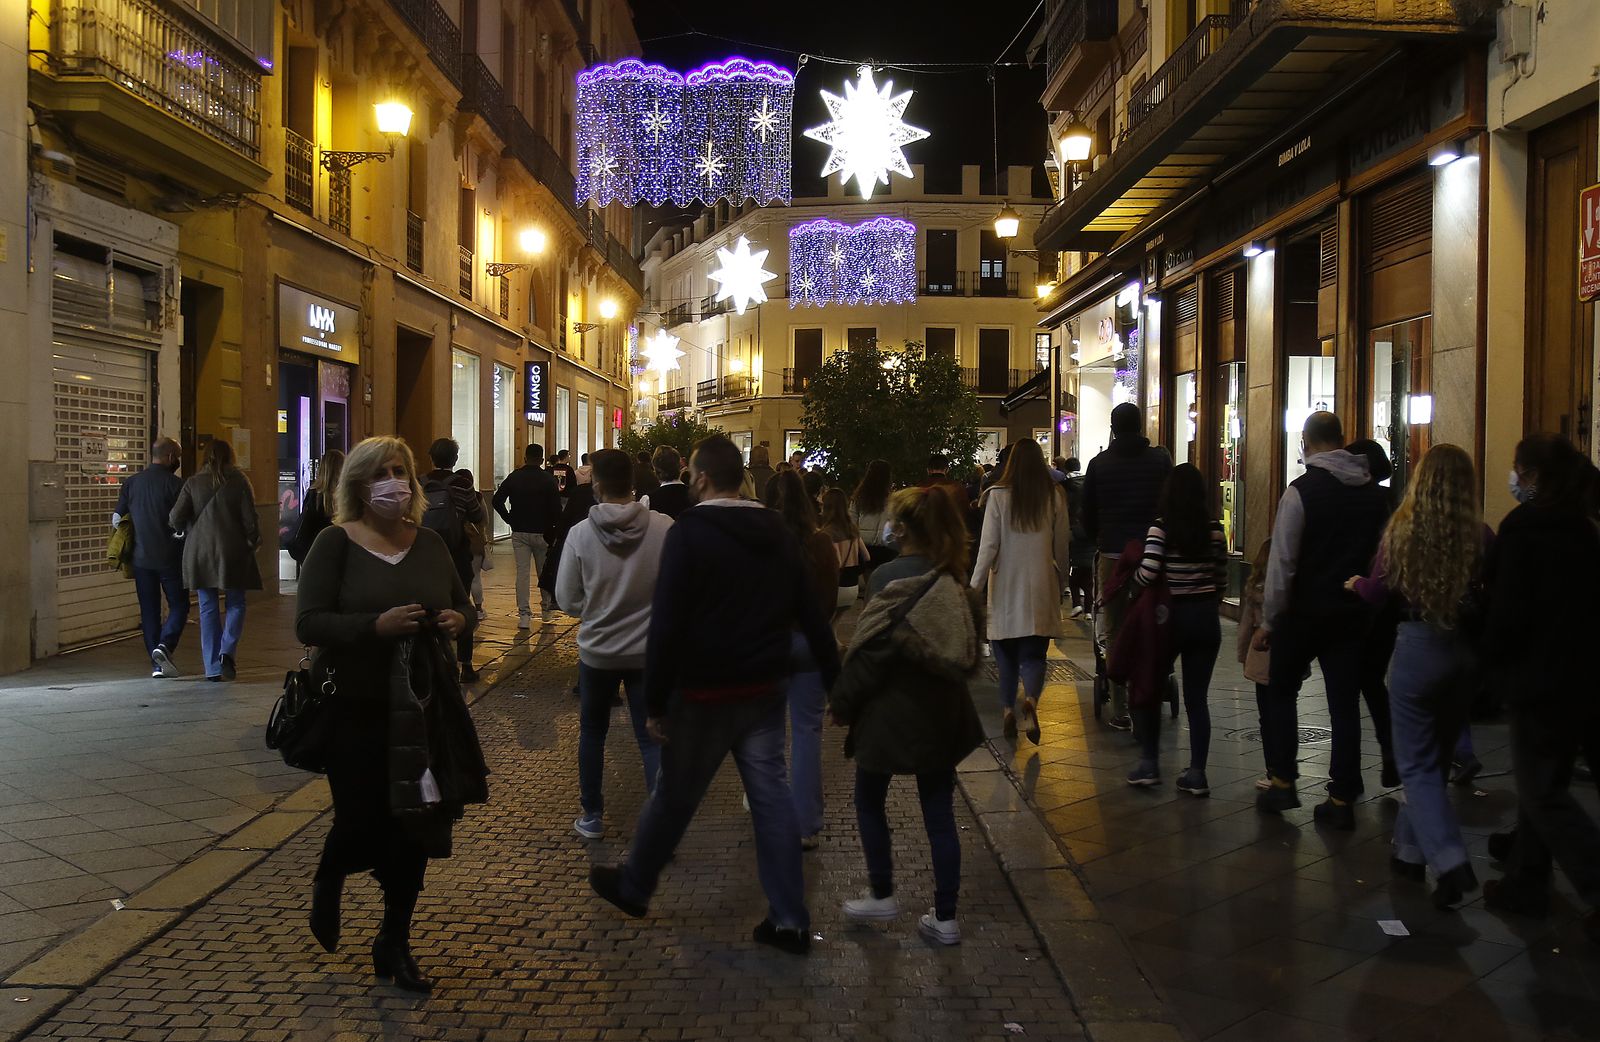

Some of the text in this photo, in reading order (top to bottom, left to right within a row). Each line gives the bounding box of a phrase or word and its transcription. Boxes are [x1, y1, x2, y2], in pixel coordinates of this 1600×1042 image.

[1278, 146, 1294, 167] BIMBA
[1298, 135, 1311, 155] LOLA
[310, 303, 335, 333] NYX
[532, 365, 541, 410] MANGO
